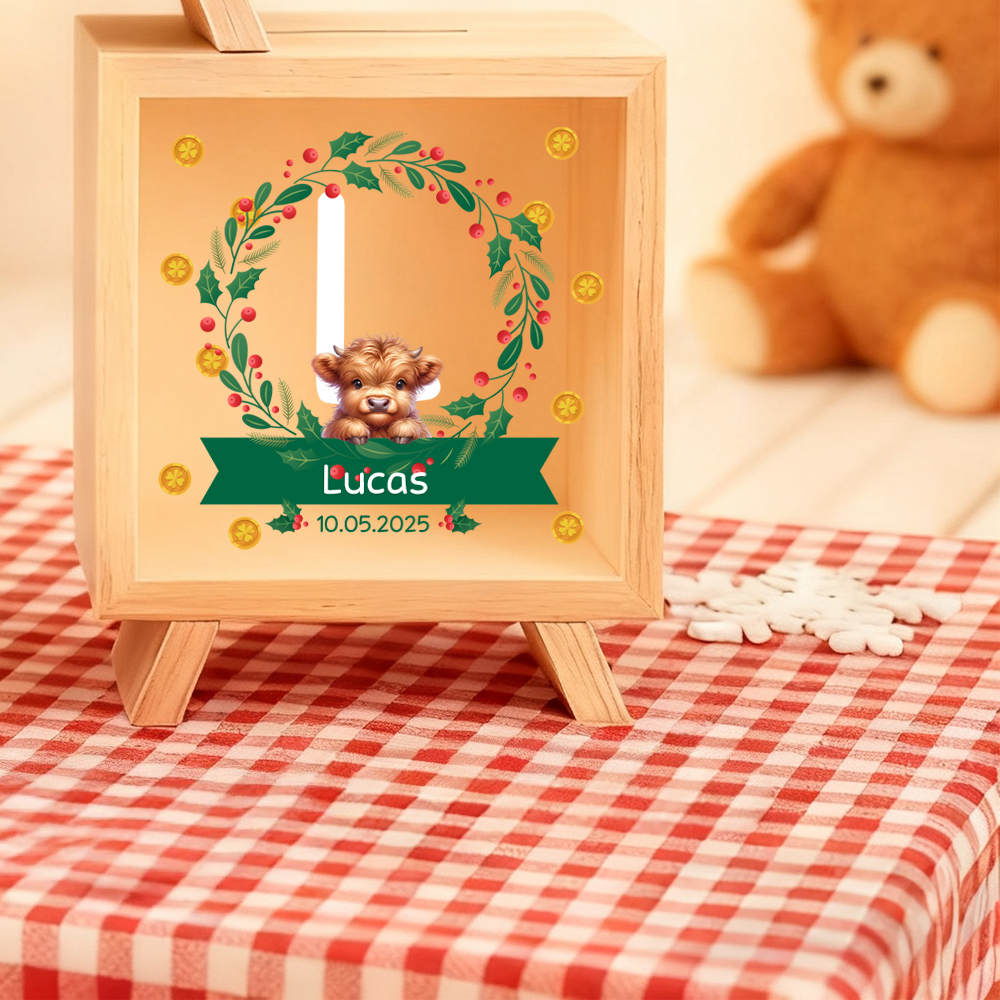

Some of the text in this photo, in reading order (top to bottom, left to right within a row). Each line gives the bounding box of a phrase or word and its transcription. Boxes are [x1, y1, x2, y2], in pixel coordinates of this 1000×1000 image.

[316, 191, 441, 404] L
[323, 465, 429, 496] Lucas
[317, 515, 429, 534] 10.05.2025
